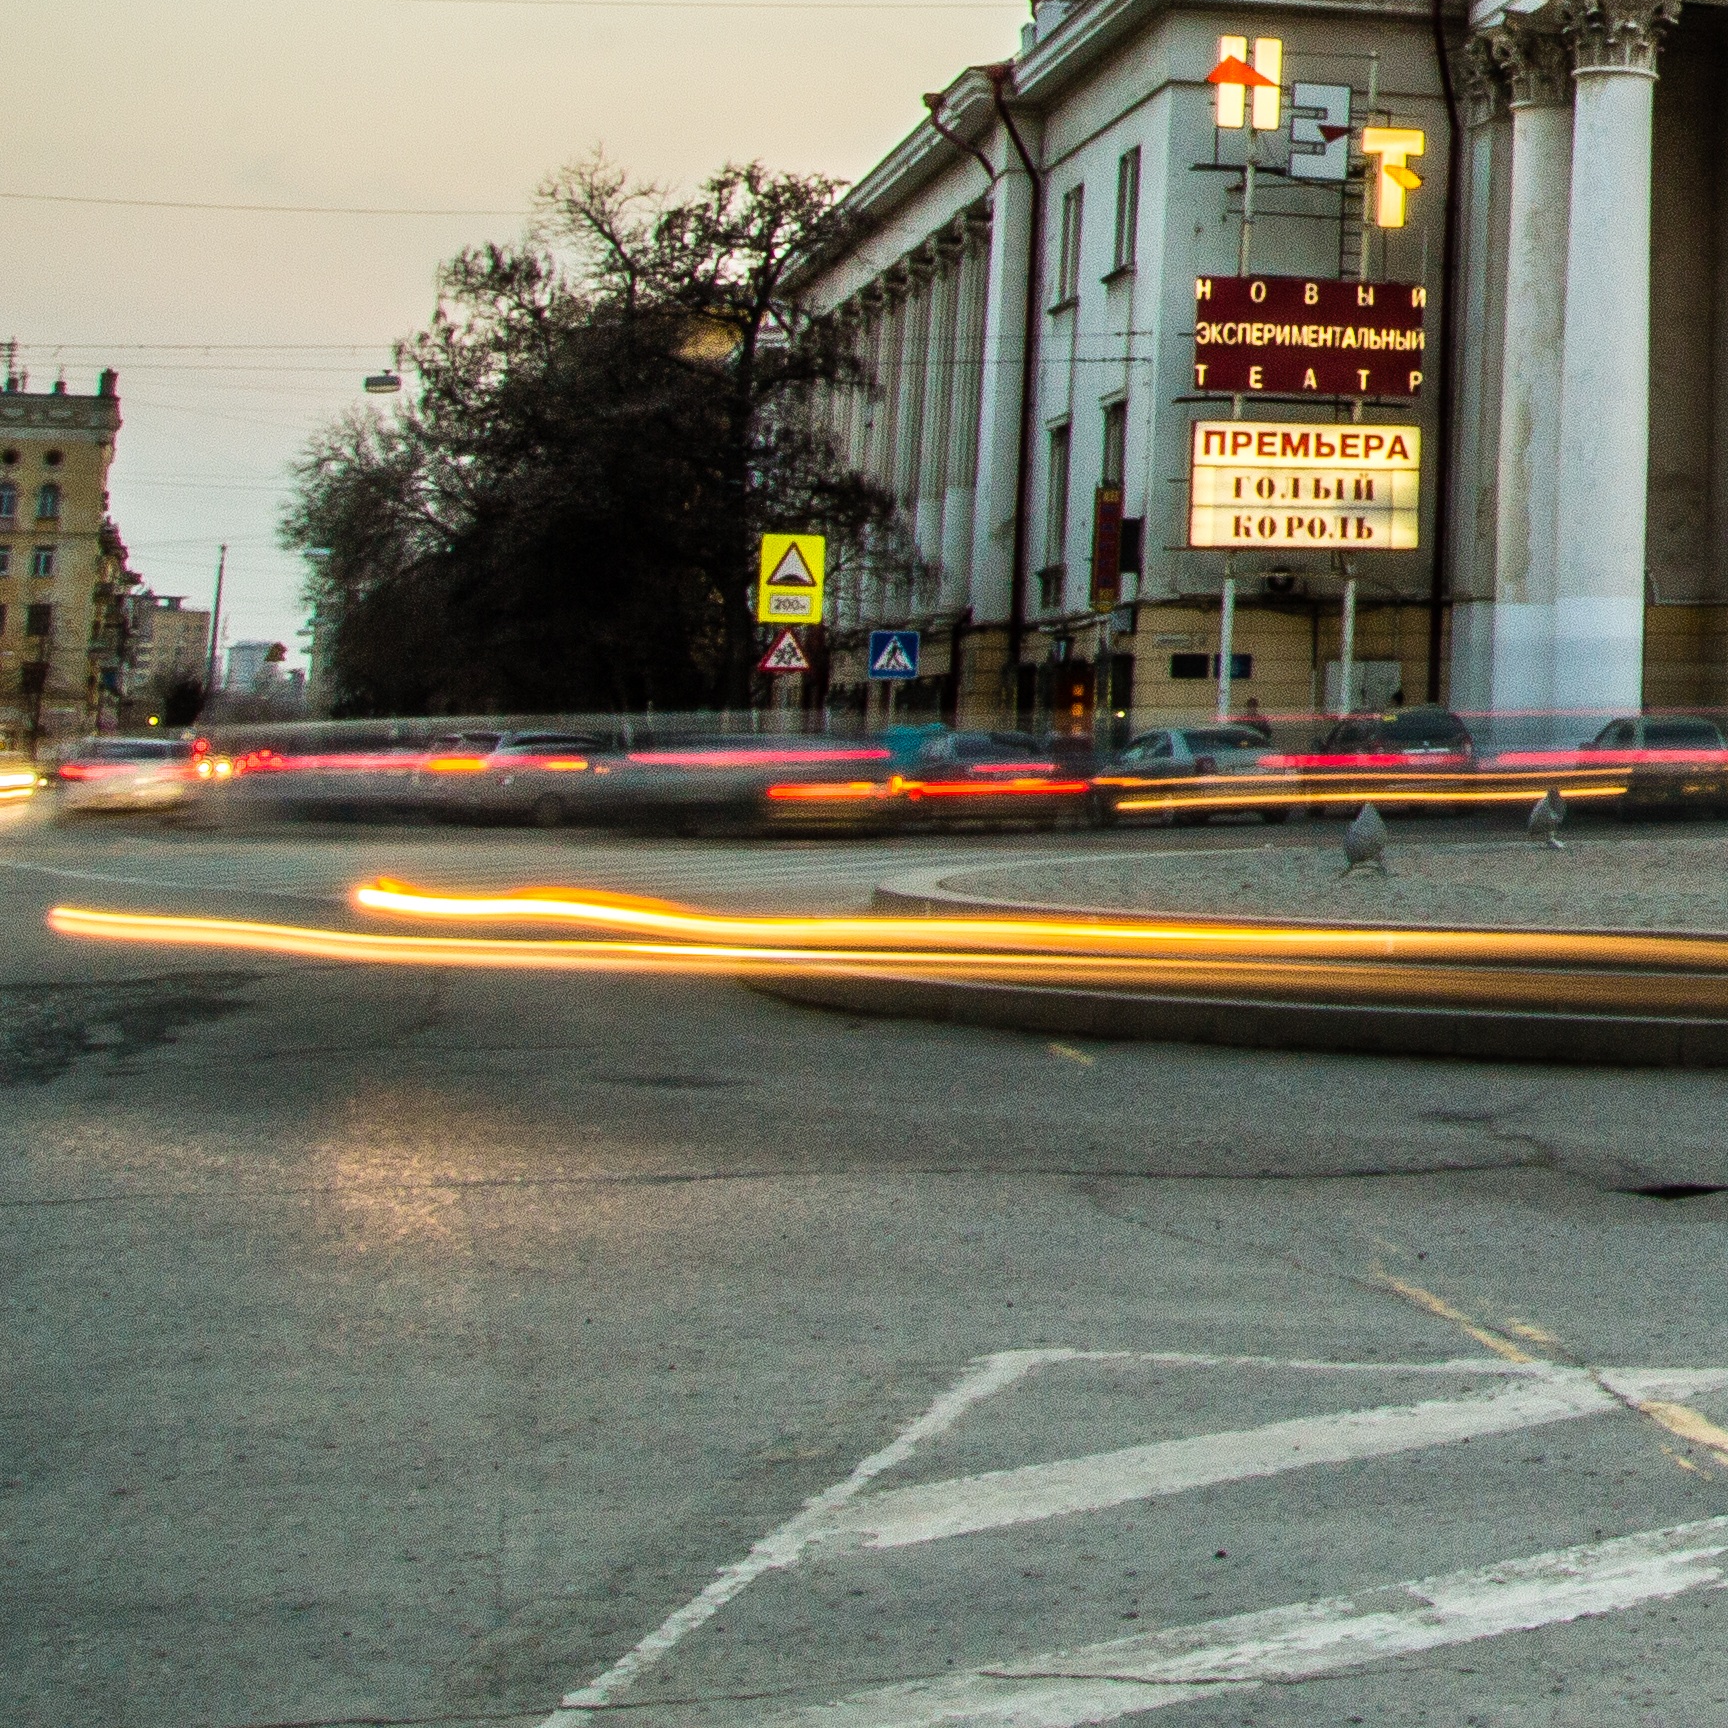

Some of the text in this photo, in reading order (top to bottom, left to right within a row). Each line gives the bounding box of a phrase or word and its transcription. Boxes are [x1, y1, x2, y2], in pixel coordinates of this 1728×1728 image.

[1195, 278, 1427, 308] НОВЫЙ
[1195, 322, 1426, 351] ЭКСПЕРИМЕНТАЛЬНЫЙ
[1195, 364, 1424, 393] ТЕАТР
[1203, 430, 1410, 460] ПРЕМЬЕРА
[1233, 474, 1375, 502] ГОЛЫЙ
[1233, 515, 1374, 539] КОРОЛЬ
